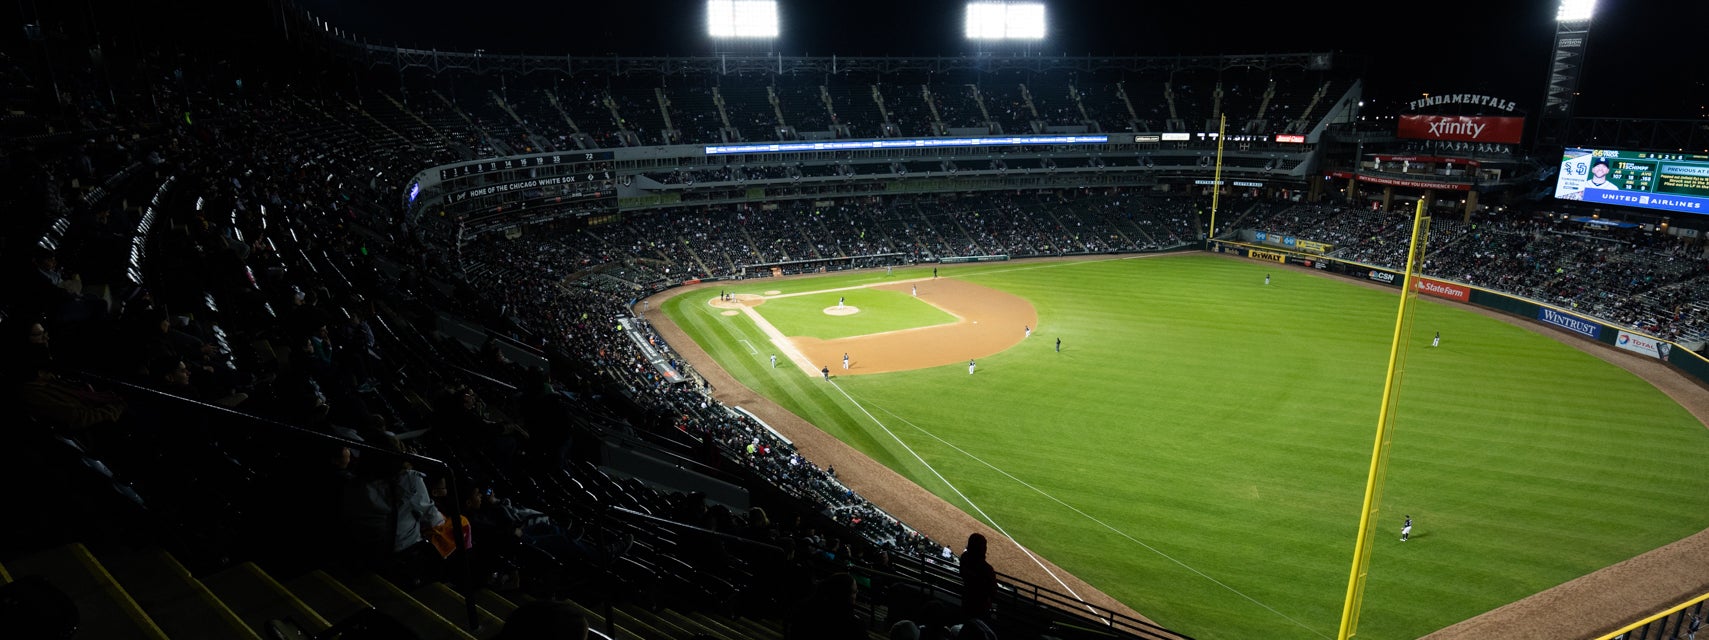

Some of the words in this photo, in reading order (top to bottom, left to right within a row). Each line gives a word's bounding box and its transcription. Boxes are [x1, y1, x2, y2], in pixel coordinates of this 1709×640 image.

[1410, 94, 1516, 112] FUNDAMENTALS
[1428, 119, 1486, 138] xfinity
[510, 180, 537, 190] CHICAGO
[1602, 193, 1638, 202] UNITED
[1651, 198, 1701, 208] AIRLINES
[1378, 272, 1394, 281] CSN
[1425, 283, 1444, 293] State
[1444, 286, 1463, 297] Farm
[1544, 309, 1596, 334] WINTRUST
[1632, 338, 1654, 349] TOTAL
